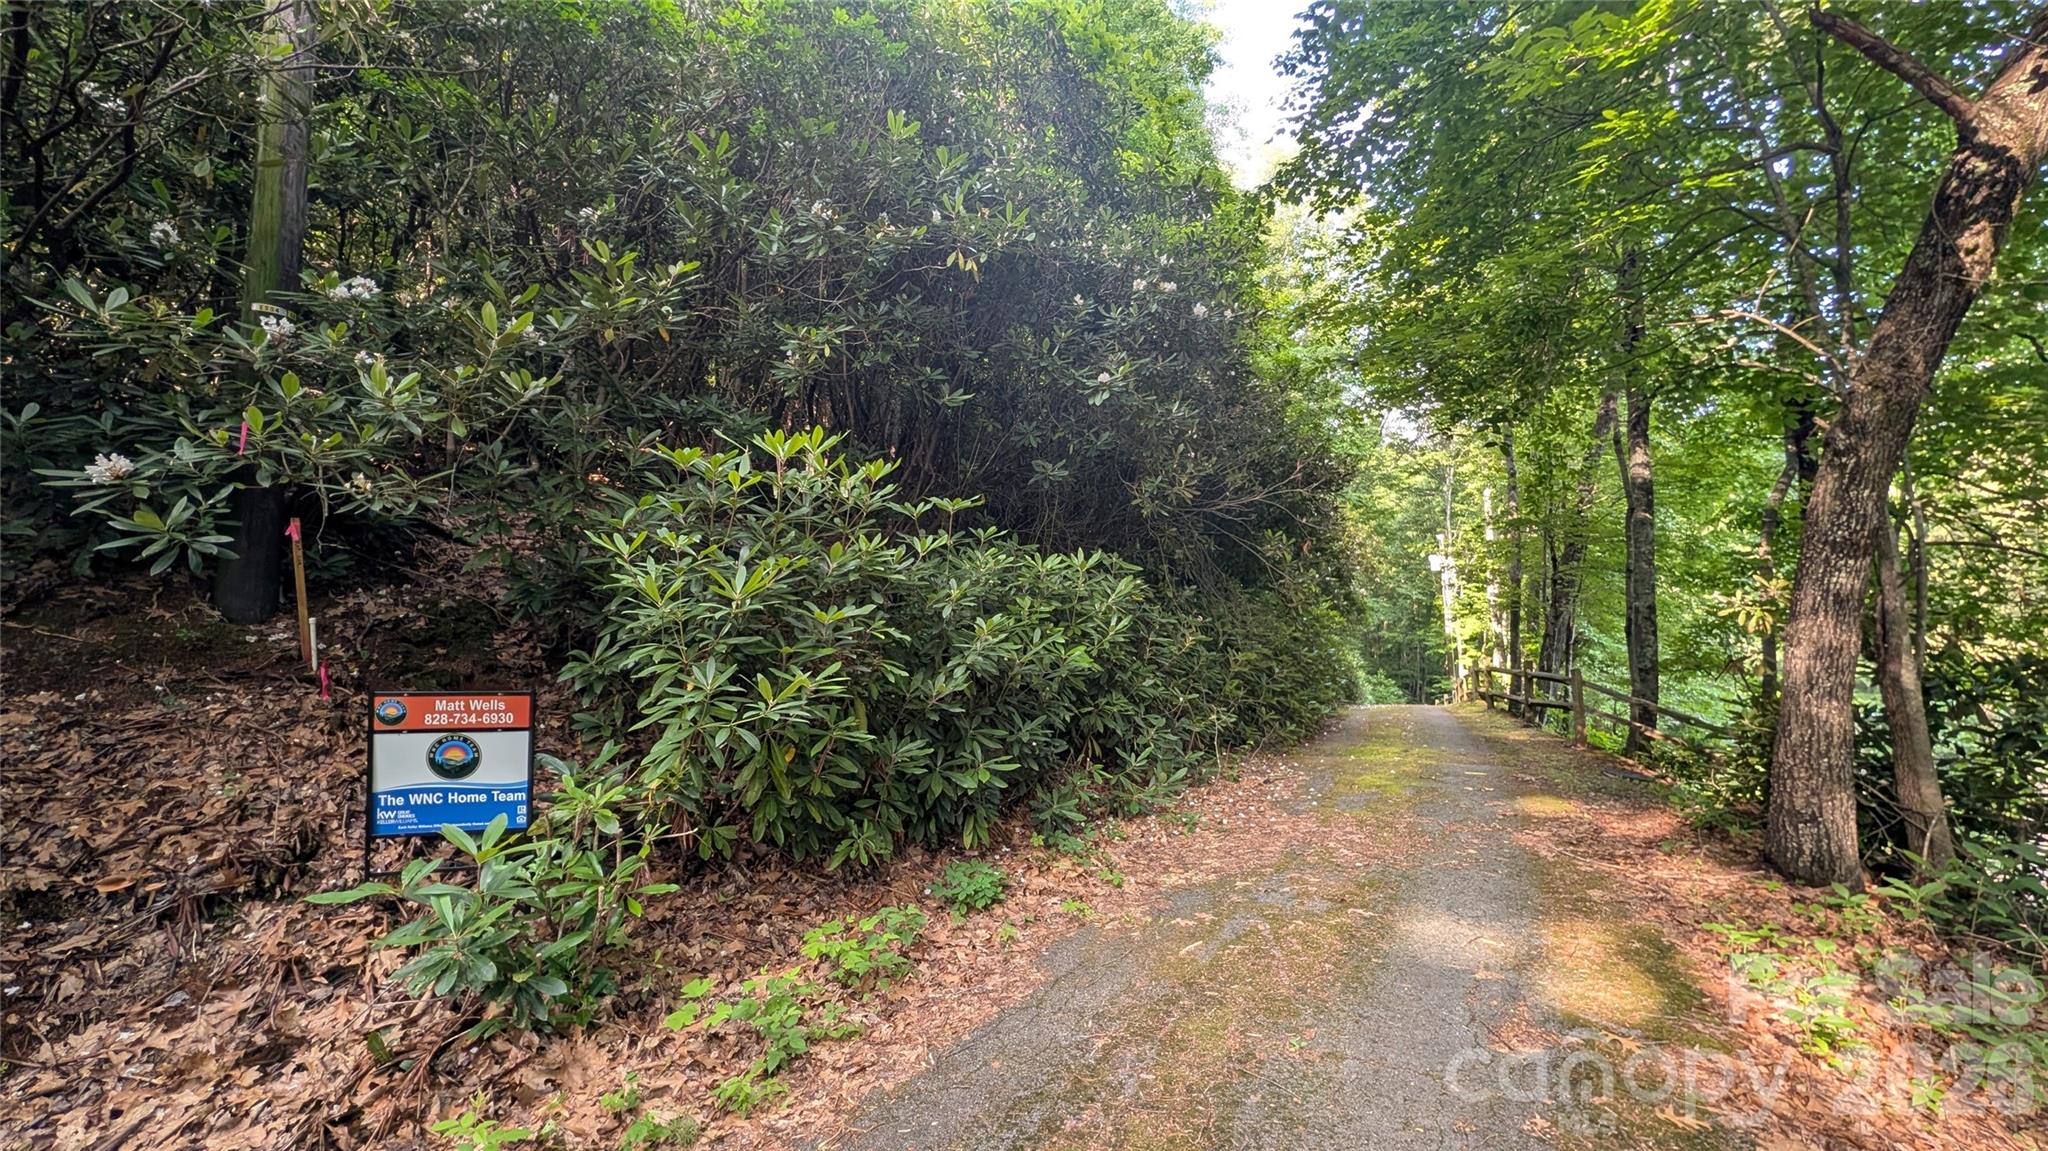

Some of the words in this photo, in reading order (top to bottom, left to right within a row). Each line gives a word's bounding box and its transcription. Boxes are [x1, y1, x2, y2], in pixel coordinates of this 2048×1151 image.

[435, 700, 465, 711] Matt
[469, 699, 506, 711] Wells
[424, 712, 514, 725] 828-734-6930
[378, 794, 405, 806] The
[408, 793, 443, 805] WNC
[448, 792, 488, 804] Home
[491, 790, 526, 802] Team
[376, 808, 397, 820] kw
